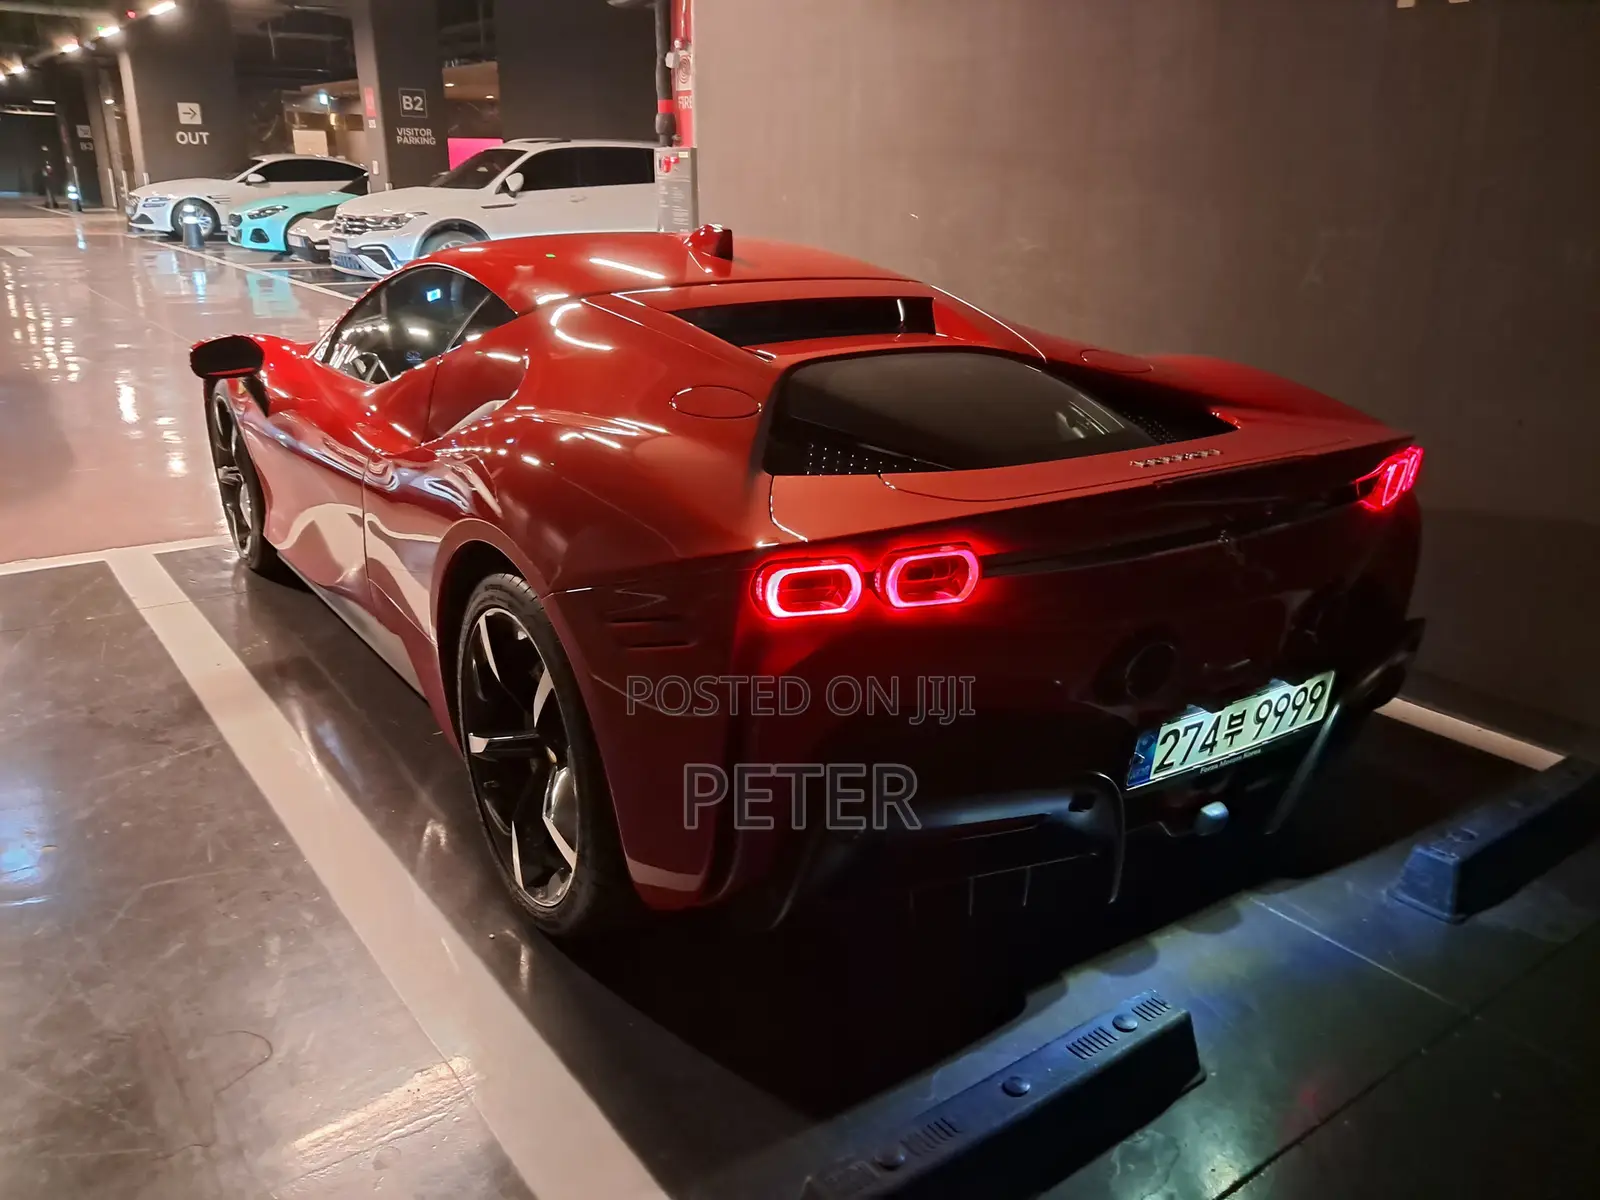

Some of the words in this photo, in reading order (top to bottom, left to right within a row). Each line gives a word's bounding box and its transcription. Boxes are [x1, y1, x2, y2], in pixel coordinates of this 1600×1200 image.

[402, 95, 424, 111] B2
[176, 131, 210, 145] OUT
[397, 127, 432, 137] VISITOR
[397, 135, 436, 146] PARKING
[1153, 709, 1247, 775] 274부
[1252, 680, 1327, 741] 9999
